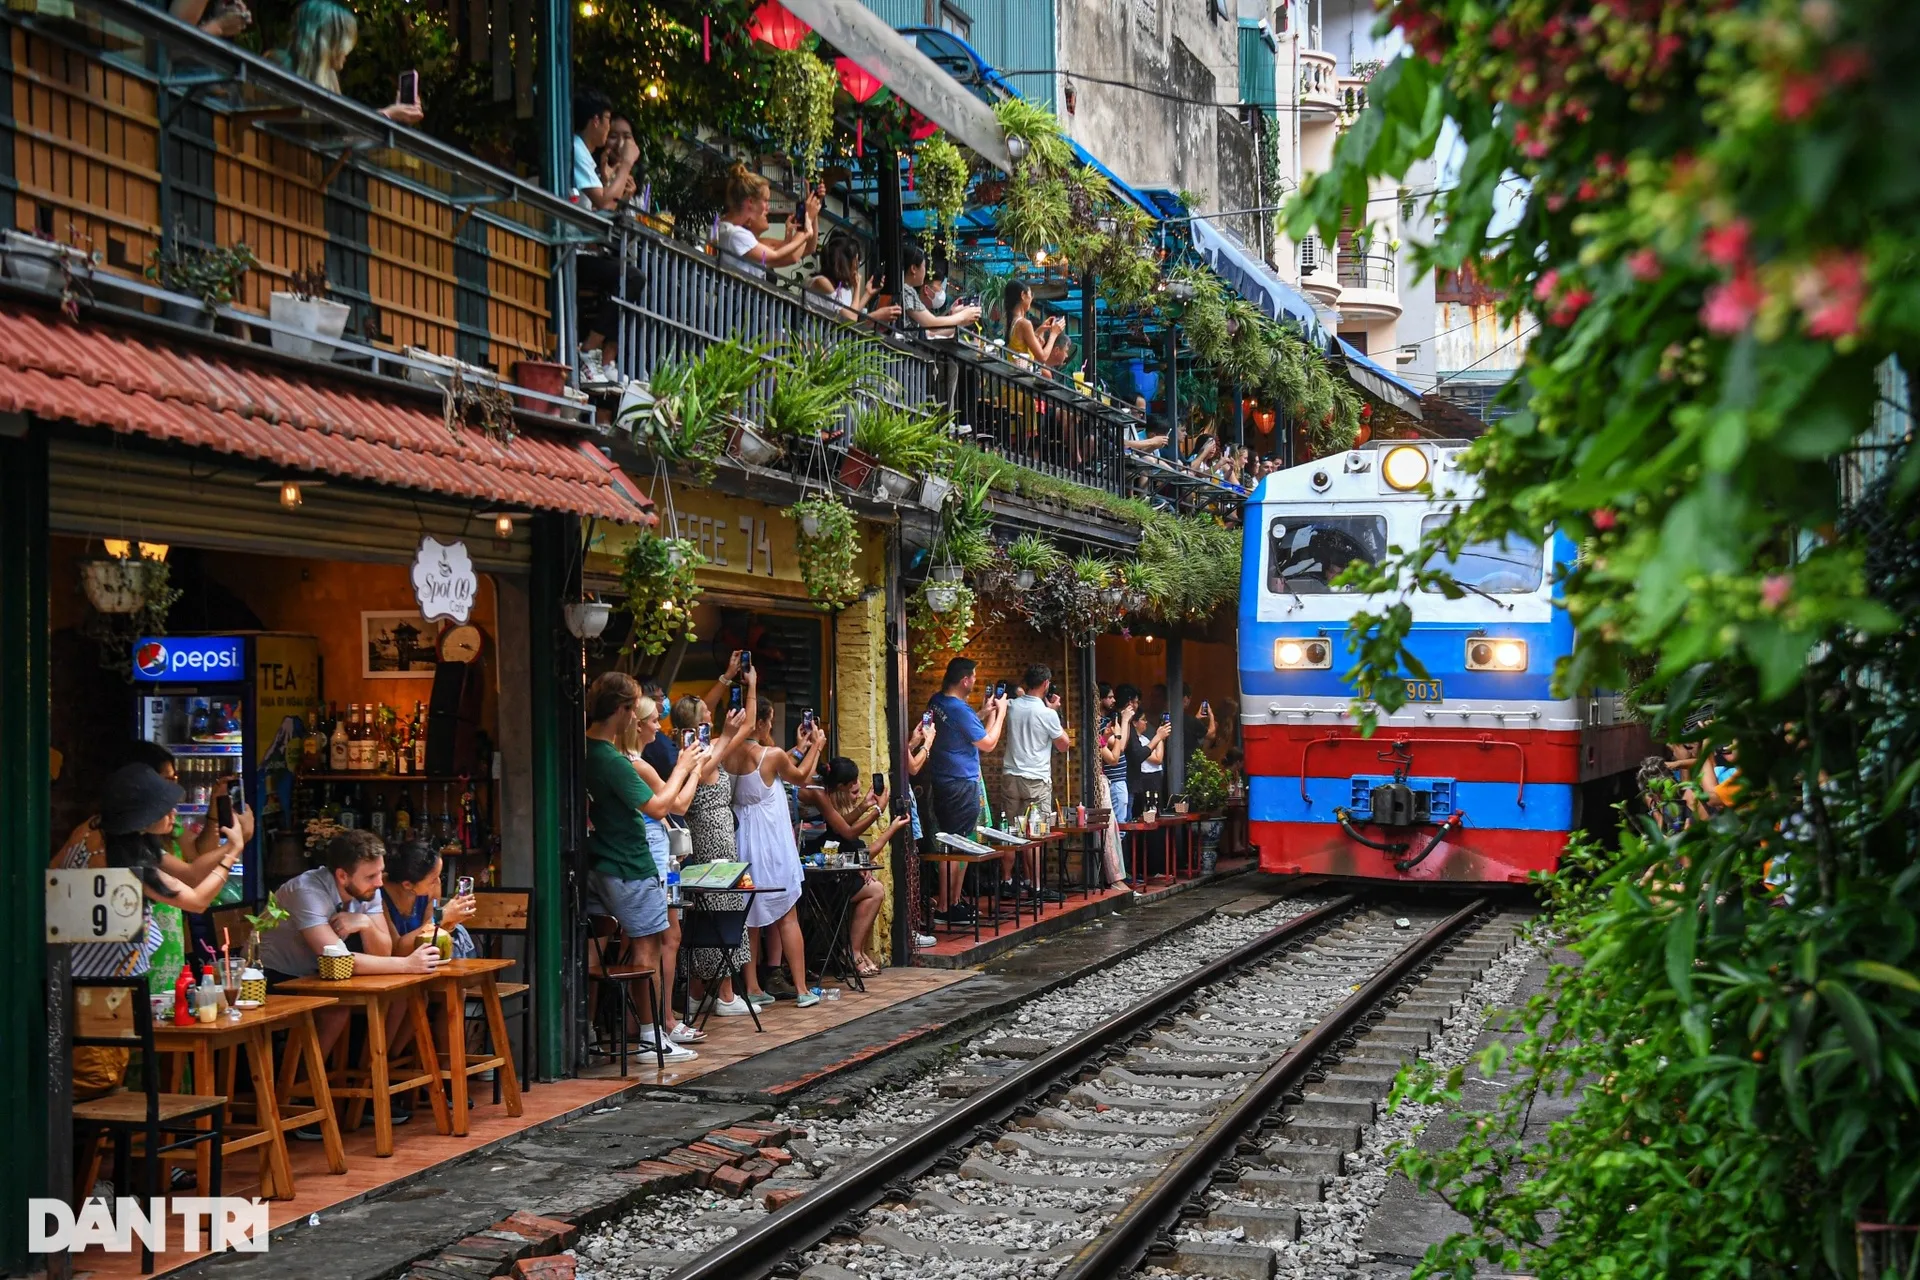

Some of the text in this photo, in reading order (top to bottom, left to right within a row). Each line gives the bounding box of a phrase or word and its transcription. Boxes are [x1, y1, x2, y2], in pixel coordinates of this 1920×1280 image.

[656, 506, 773, 577] FFEE 74
[421, 573, 470, 603] Spot 09
[172, 647, 236, 672] pepsi
[260, 663, 297, 690] TEA
[1406, 682, 1438, 700] 903
